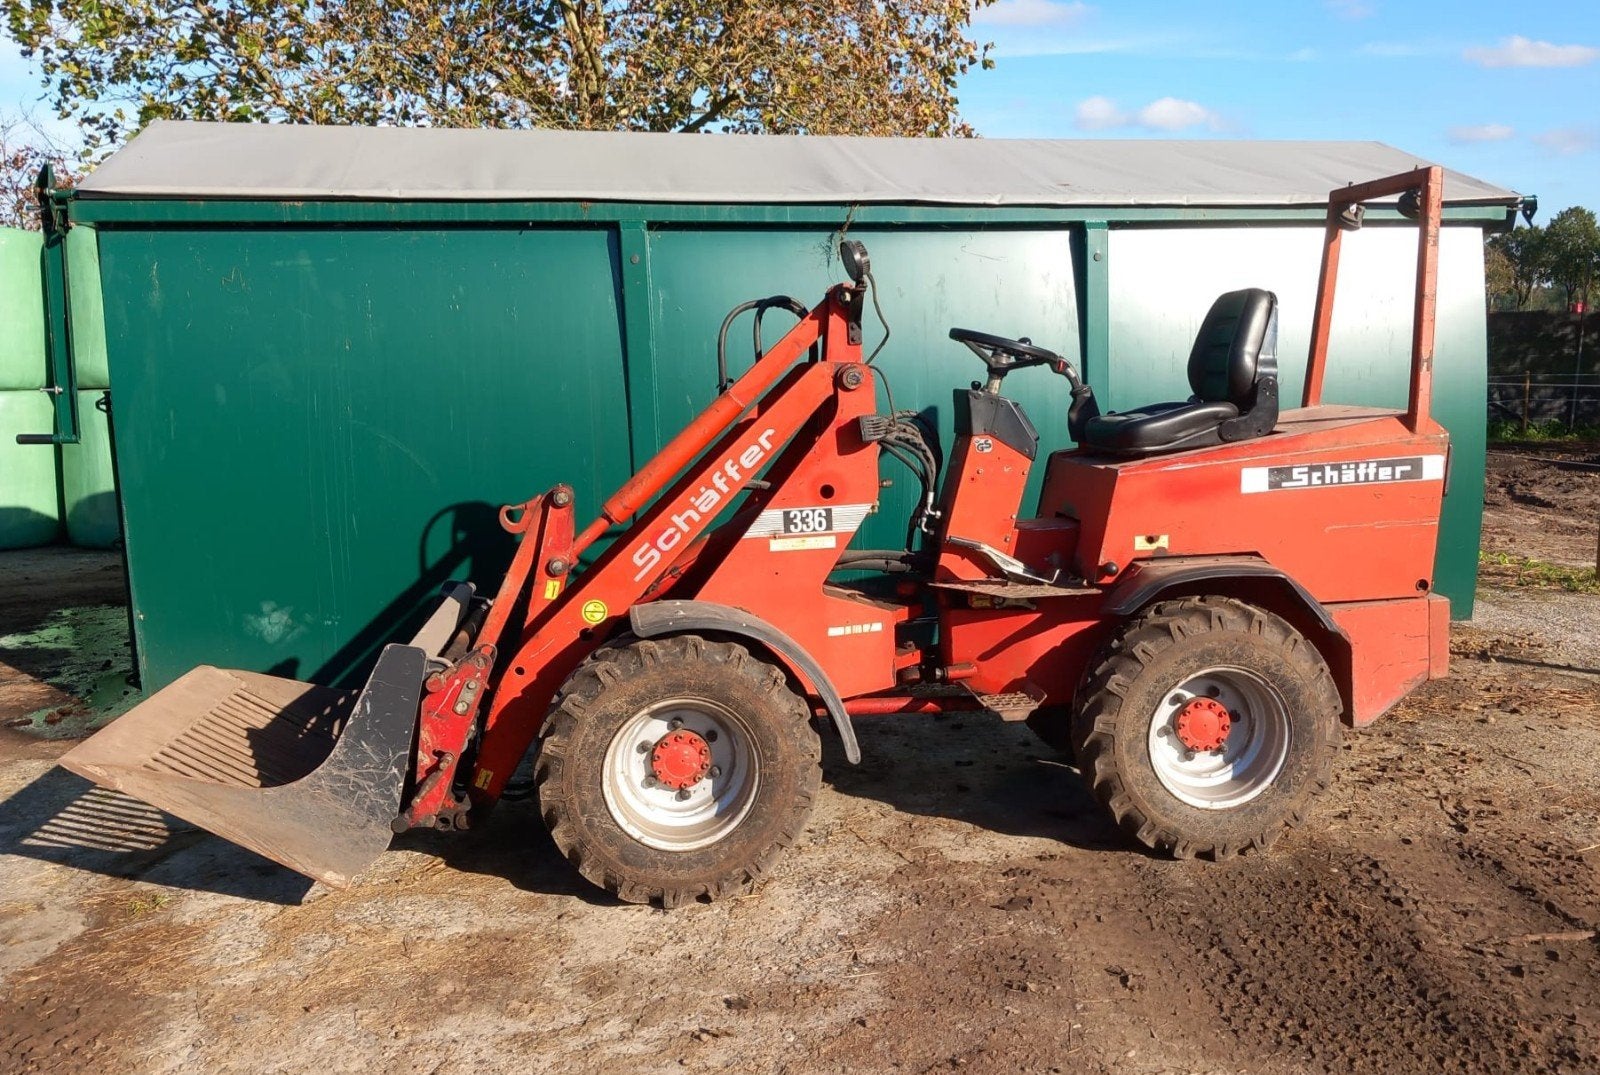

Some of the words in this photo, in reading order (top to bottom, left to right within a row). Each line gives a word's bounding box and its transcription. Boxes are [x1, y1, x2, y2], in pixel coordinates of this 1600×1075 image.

[1281, 462, 1412, 487] Schäffer
[632, 428, 775, 582] Schäffer
[789, 509, 827, 532] 336
